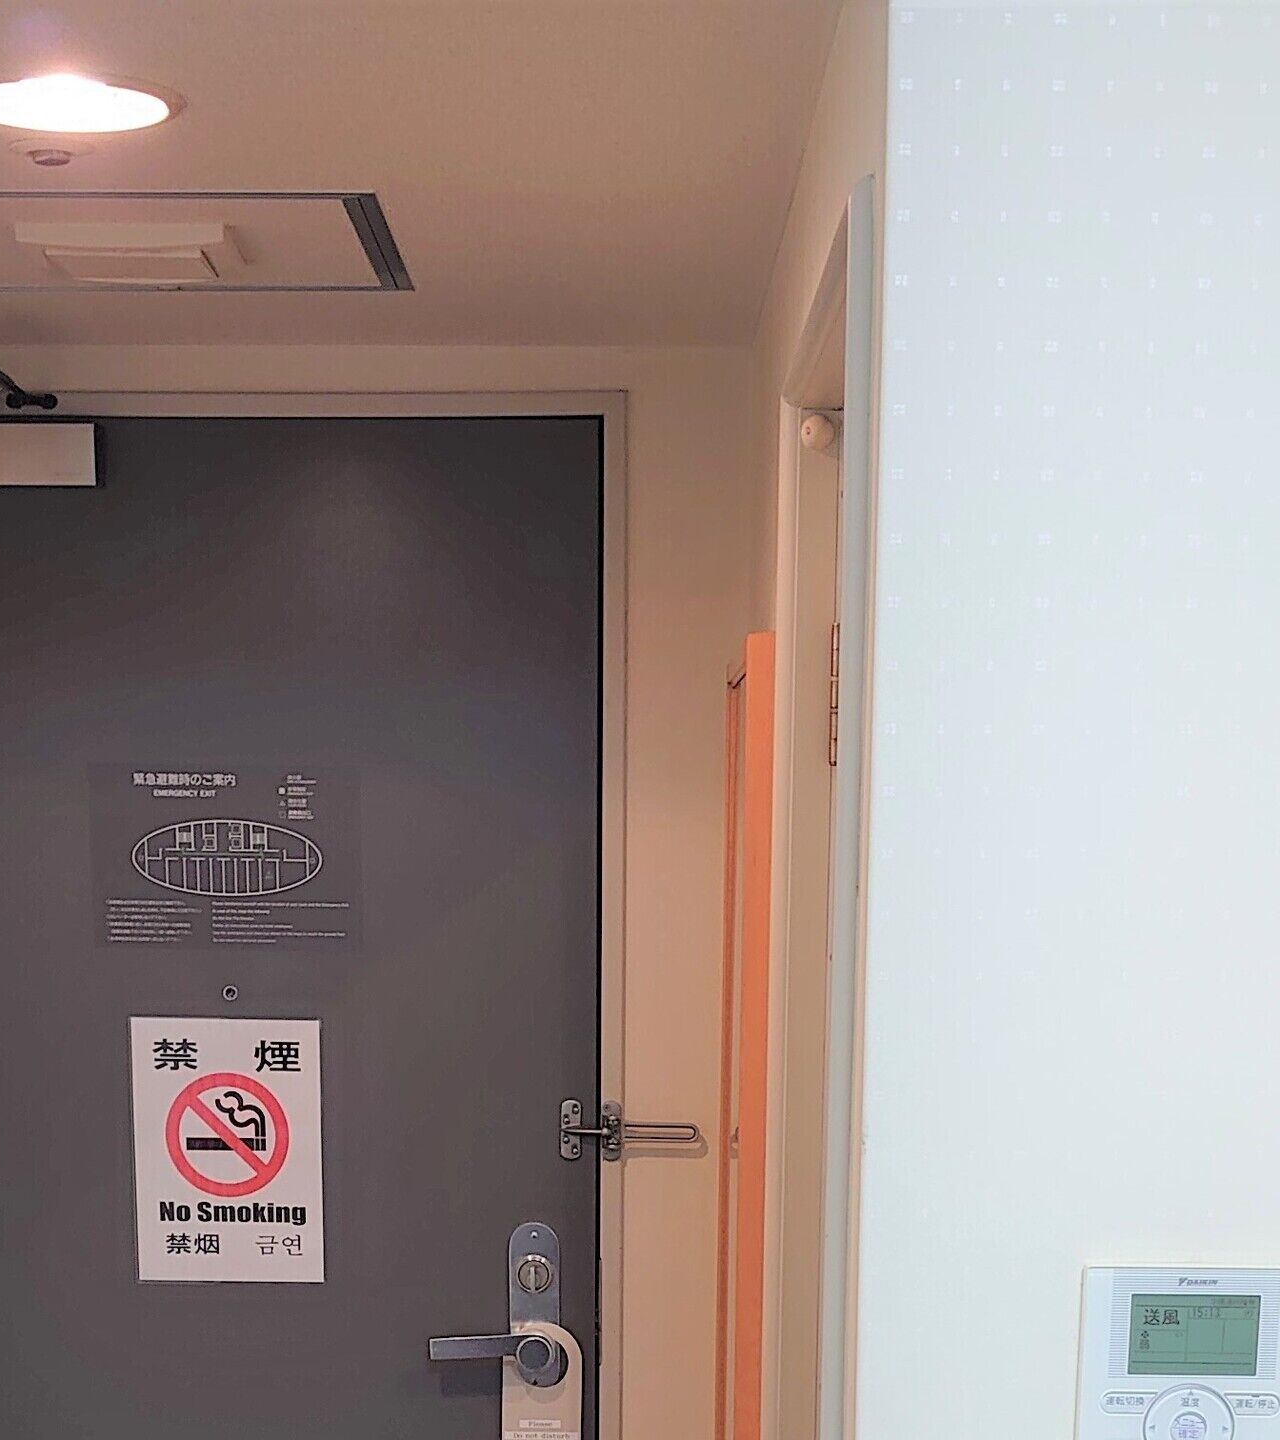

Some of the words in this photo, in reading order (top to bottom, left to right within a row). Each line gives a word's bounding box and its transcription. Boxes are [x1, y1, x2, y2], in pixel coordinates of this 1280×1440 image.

[153, 788, 198, 798] EMERGENCY
[199, 789, 216, 798] EXIT
[159, 1201, 191, 1223] No
[197, 1202, 307, 1226] Smoking
[165, 1232, 221, 1255] 禁烟
[255, 1233, 304, 1256] 금연
[1143, 1308, 1180, 1326] 送風
